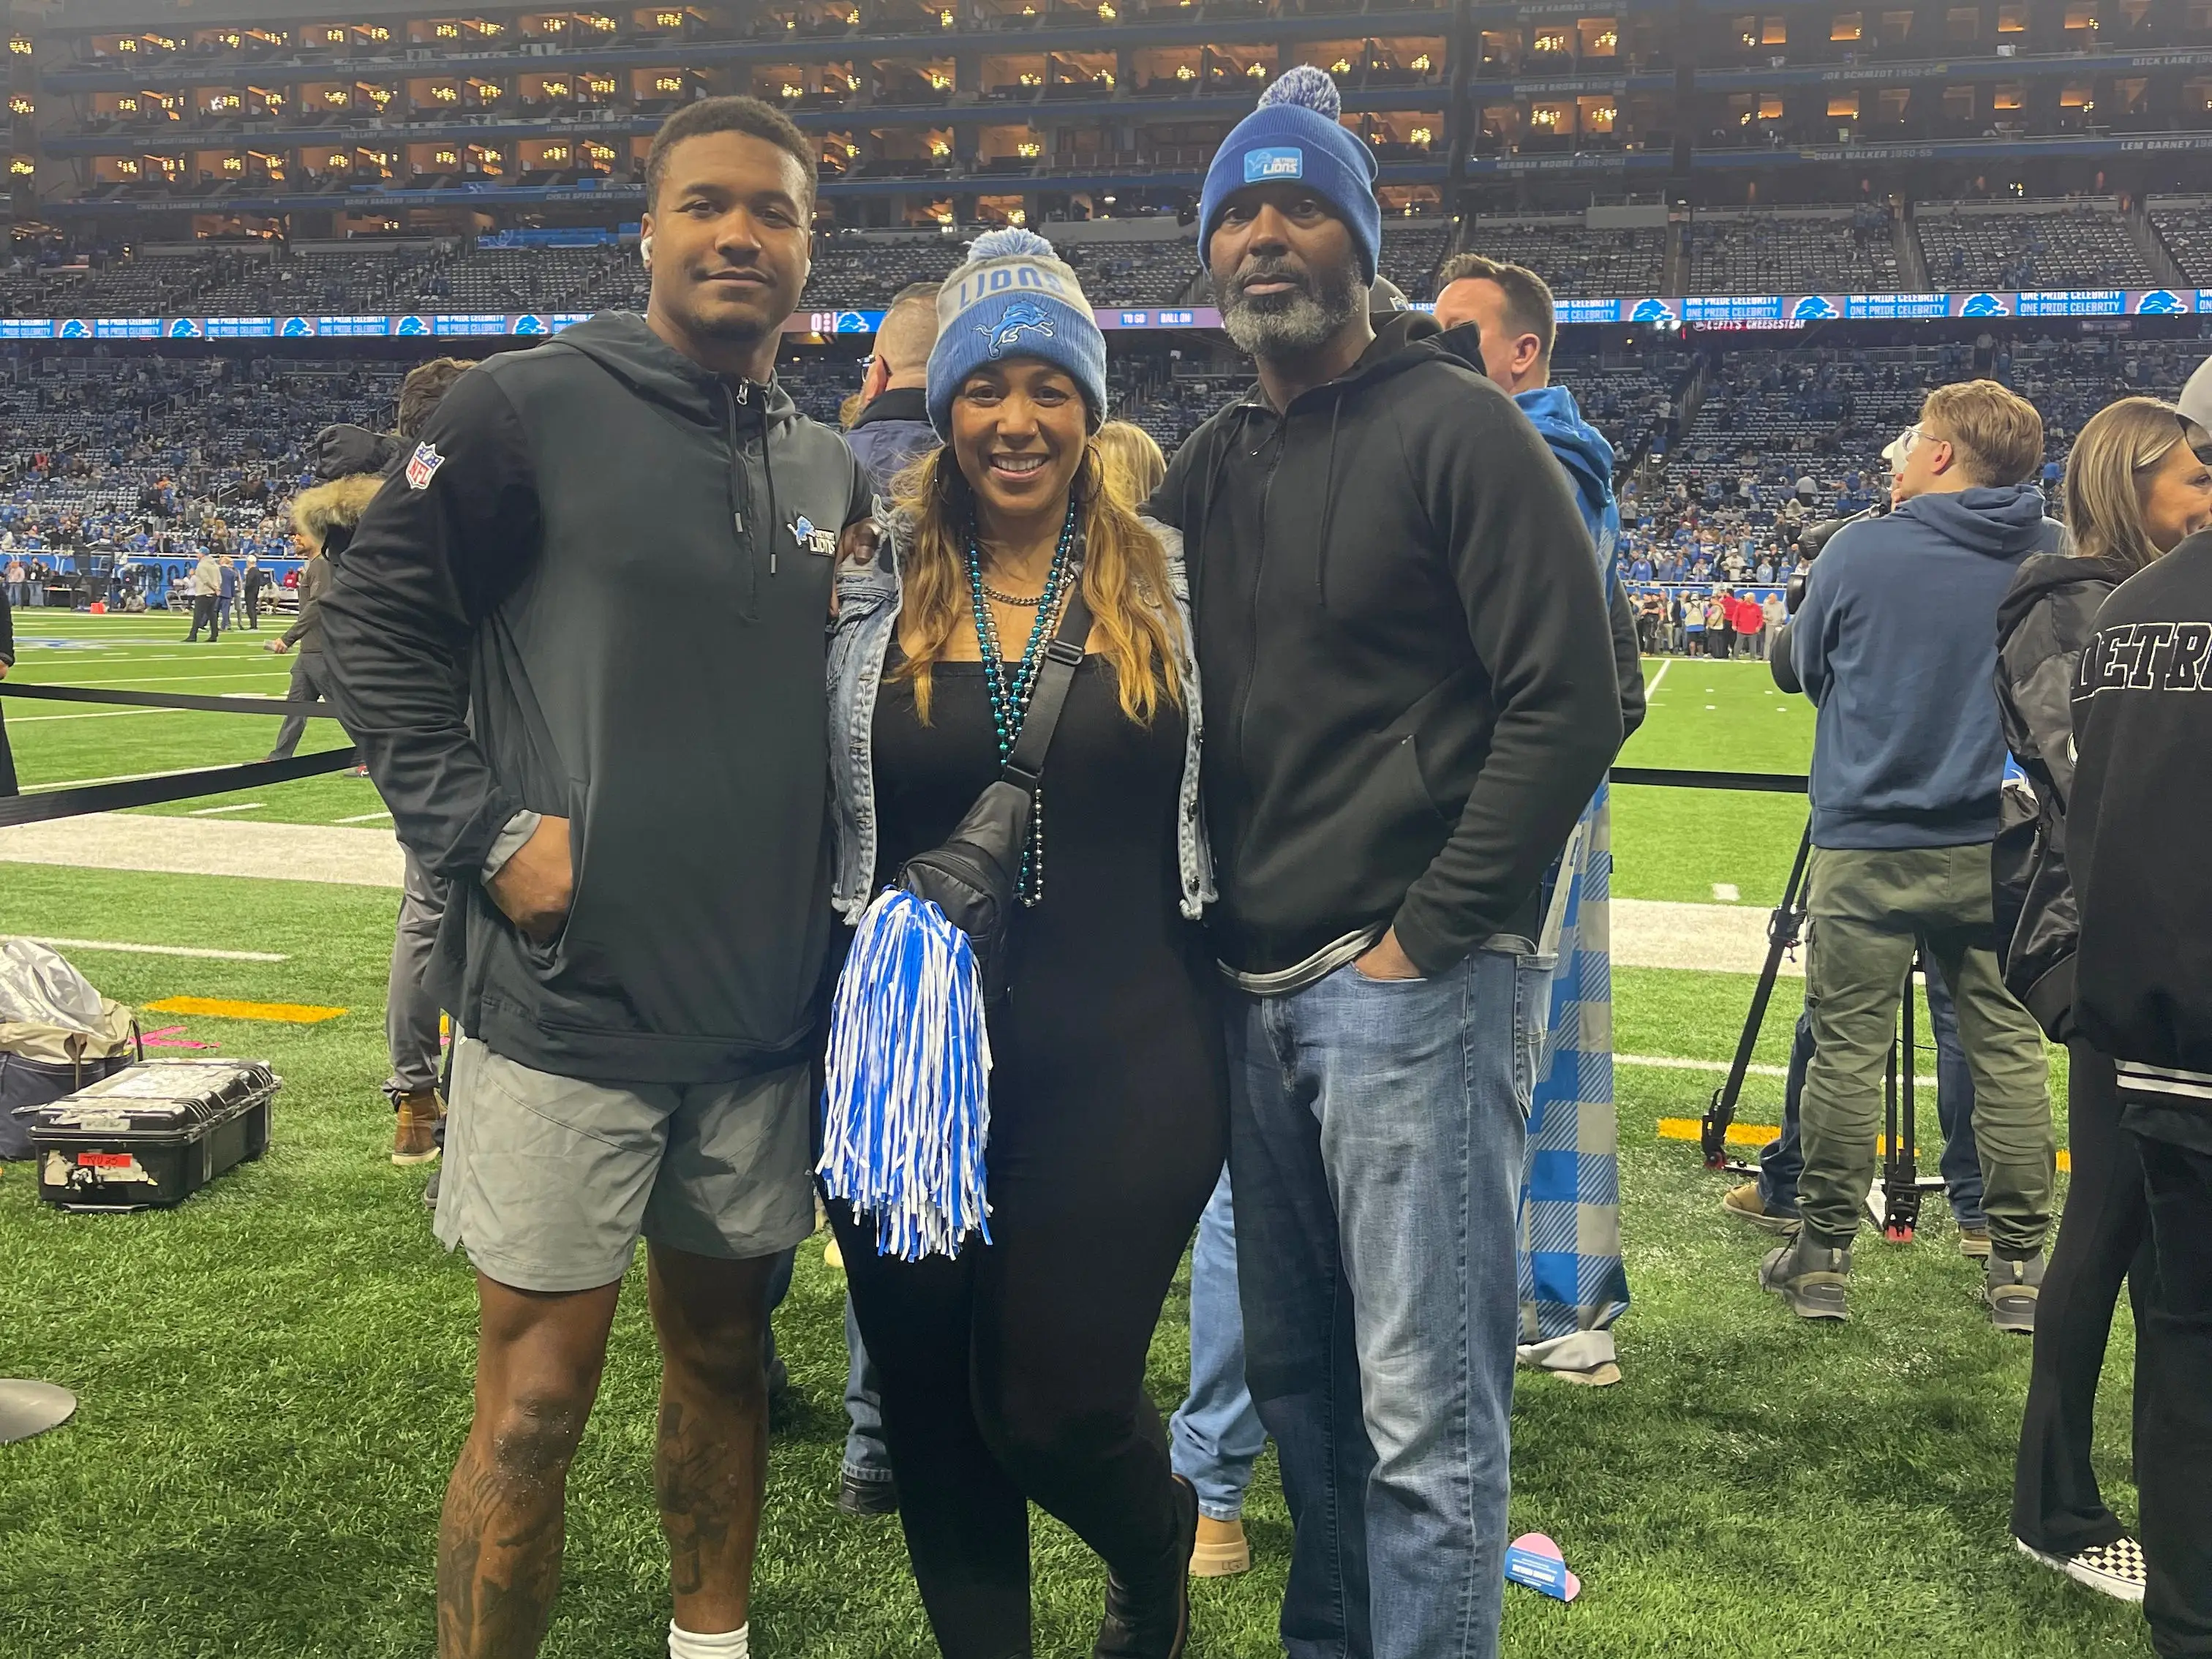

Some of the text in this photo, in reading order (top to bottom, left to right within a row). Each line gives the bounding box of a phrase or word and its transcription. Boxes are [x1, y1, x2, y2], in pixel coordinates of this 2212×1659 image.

[1850, 305, 1944, 315] ONE PRIDE CELEBRITY
[2021, 301, 2120, 312] ONE PRIDE CELEBRITY
[1571, 309, 1615, 320] CELEBRITY
[1686, 308, 1778, 318] ONE PRIDE CELEBRITY
[437, 323, 504, 332] ONE PRIDE CELEBRITY
[809, 535, 835, 554] LIONS
